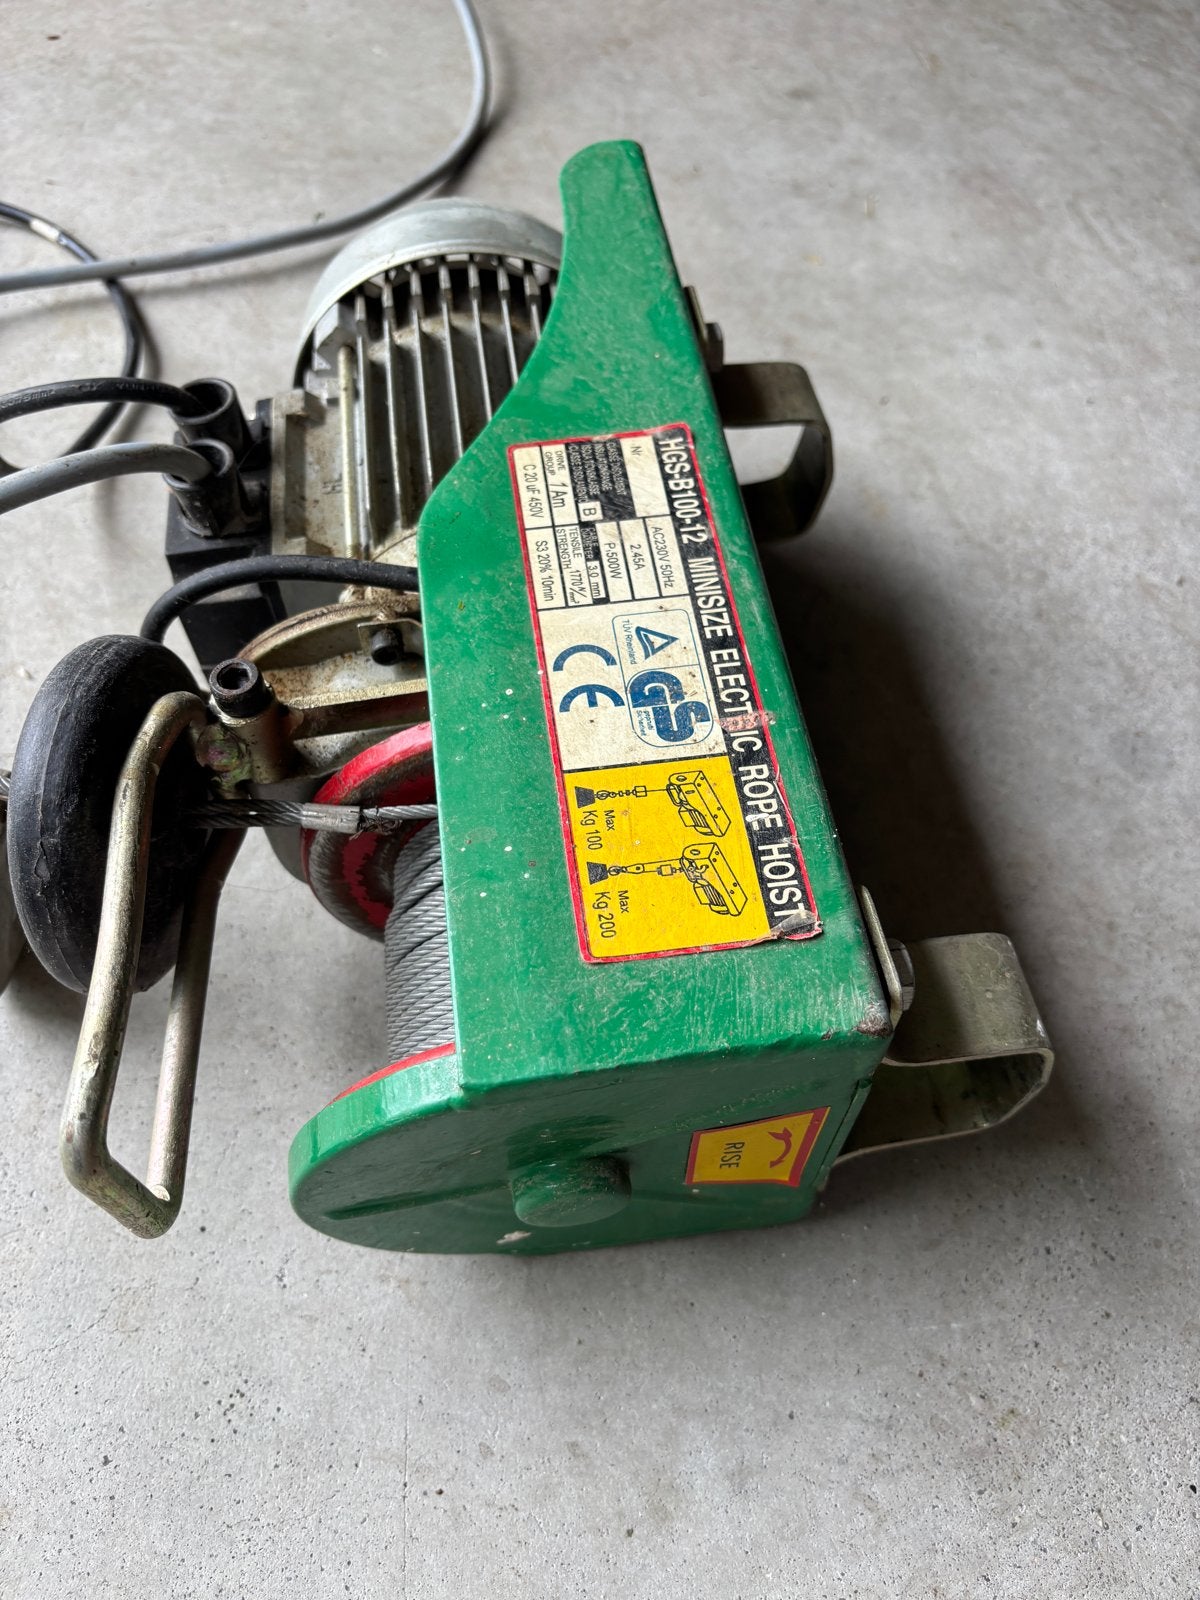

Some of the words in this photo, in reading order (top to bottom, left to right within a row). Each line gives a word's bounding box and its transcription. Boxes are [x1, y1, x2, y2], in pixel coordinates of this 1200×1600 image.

[554, 450, 566, 471] DRIVE
[630, 446, 642, 456] Nr
[544, 451, 556, 476] GROUP
[524, 472, 538, 482] 20
[658, 437, 708, 544] HGS-B100-12
[529, 497, 544, 518] 450V
[582, 507, 597, 516] B
[535, 540, 549, 552] S3
[556, 528, 572, 569] STRENGTH
[569, 527, 582, 559] TENSILE
[651, 526, 671, 562] AC230V
[537, 554, 552, 573] 20%
[630, 543, 645, 571] 2.45A
[588, 565, 599, 578] 3.0
[660, 564, 675, 588] 50Hz
[541, 575, 556, 602] 10min
[591, 582, 601, 597] mm
[687, 556, 734, 640] MINISIZE
[625, 634, 637, 664] Rheinland
[552, 644, 625, 713] CE
[709, 648, 763, 753] ELECTIC
[738, 764, 783, 831] ROPE
[580, 810, 597, 826] Kg
[603, 809, 616, 831] Max
[586, 830, 603, 850] 100
[757, 843, 805, 918] HOIST
[592, 892, 610, 910] Kg
[618, 890, 630, 913] Max
[598, 913, 617, 939] 200
[719, 1141, 745, 1169] RISE
